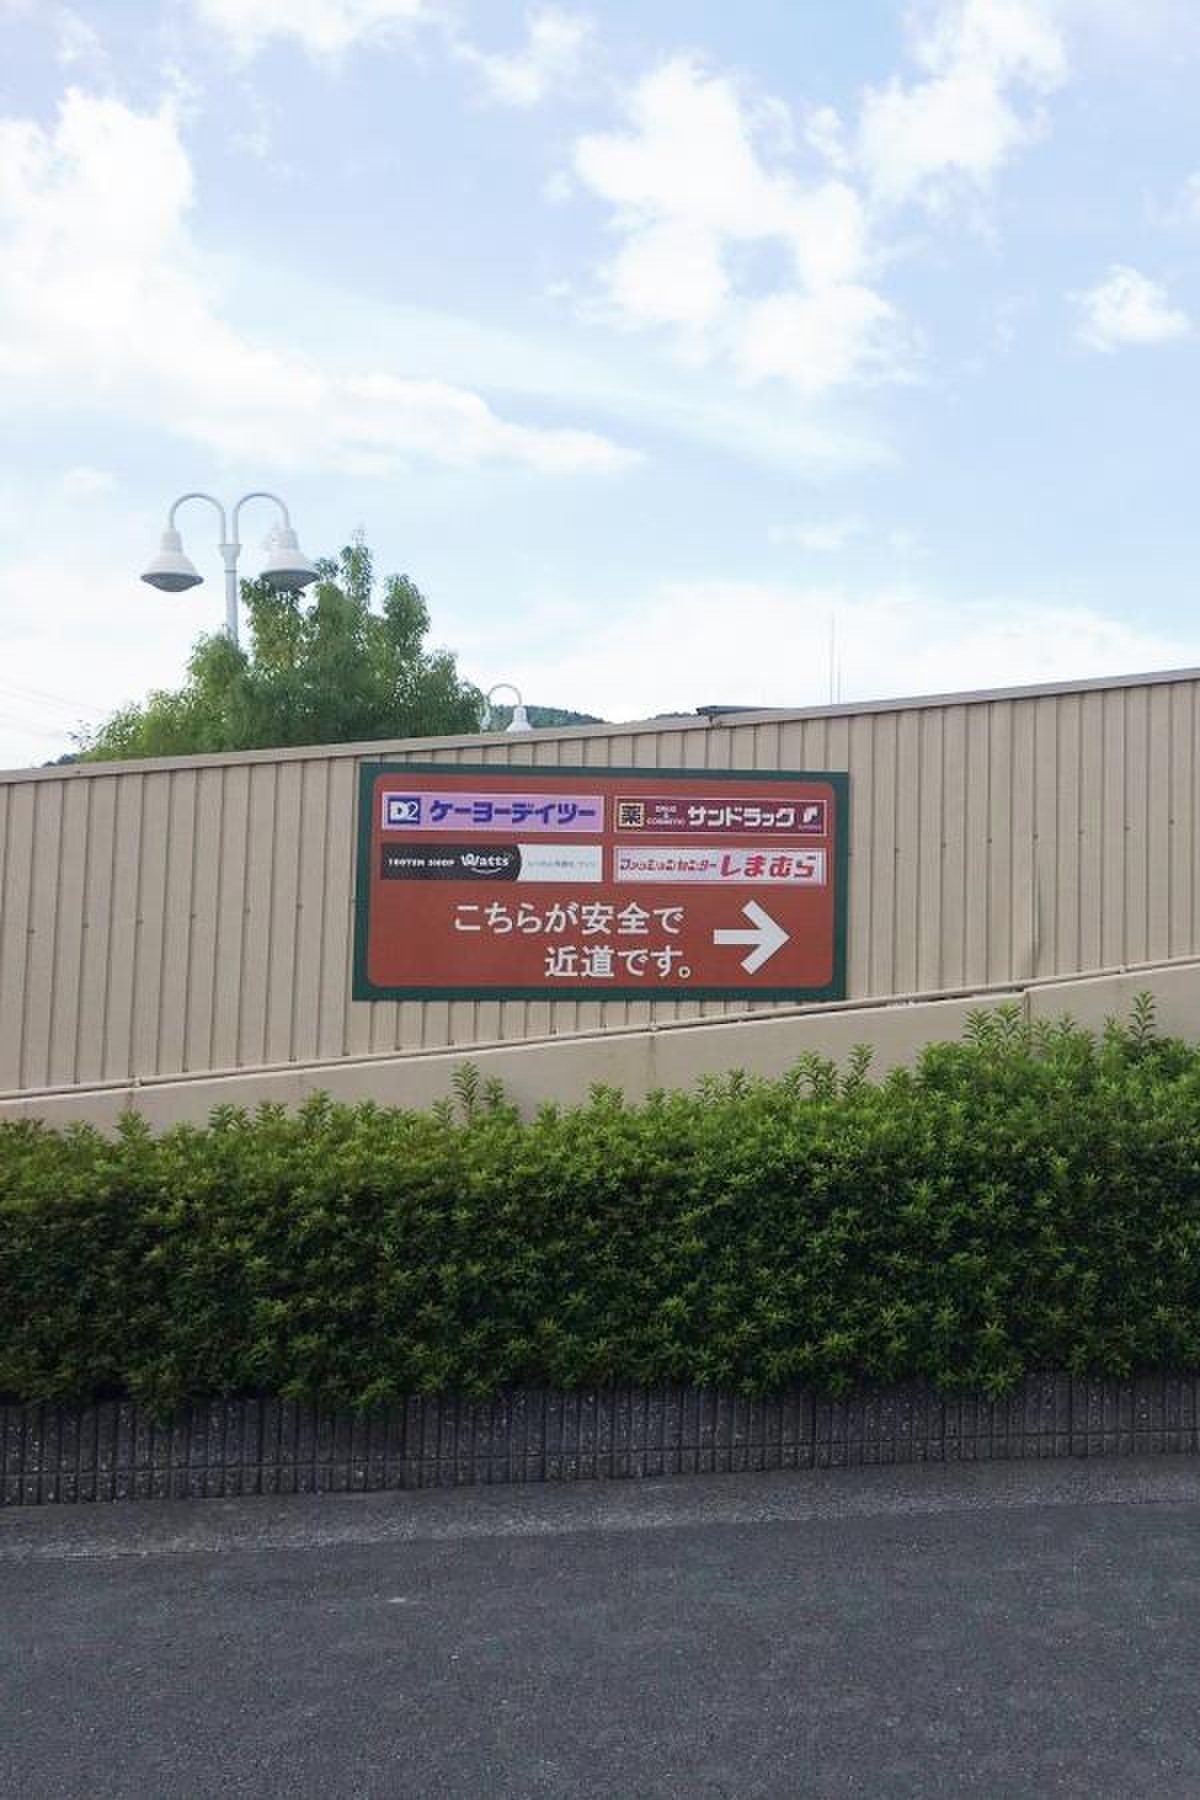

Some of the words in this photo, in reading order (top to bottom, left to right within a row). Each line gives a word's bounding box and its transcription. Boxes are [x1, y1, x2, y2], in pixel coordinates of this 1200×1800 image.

[389, 800, 419, 822] D2
[621, 804, 642, 825] 薬
[460, 853, 510, 867] Watts
[720, 854, 817, 877] しまむら
[453, 901, 684, 935] こちらが安全で
[544, 945, 693, 978] 近道です。
